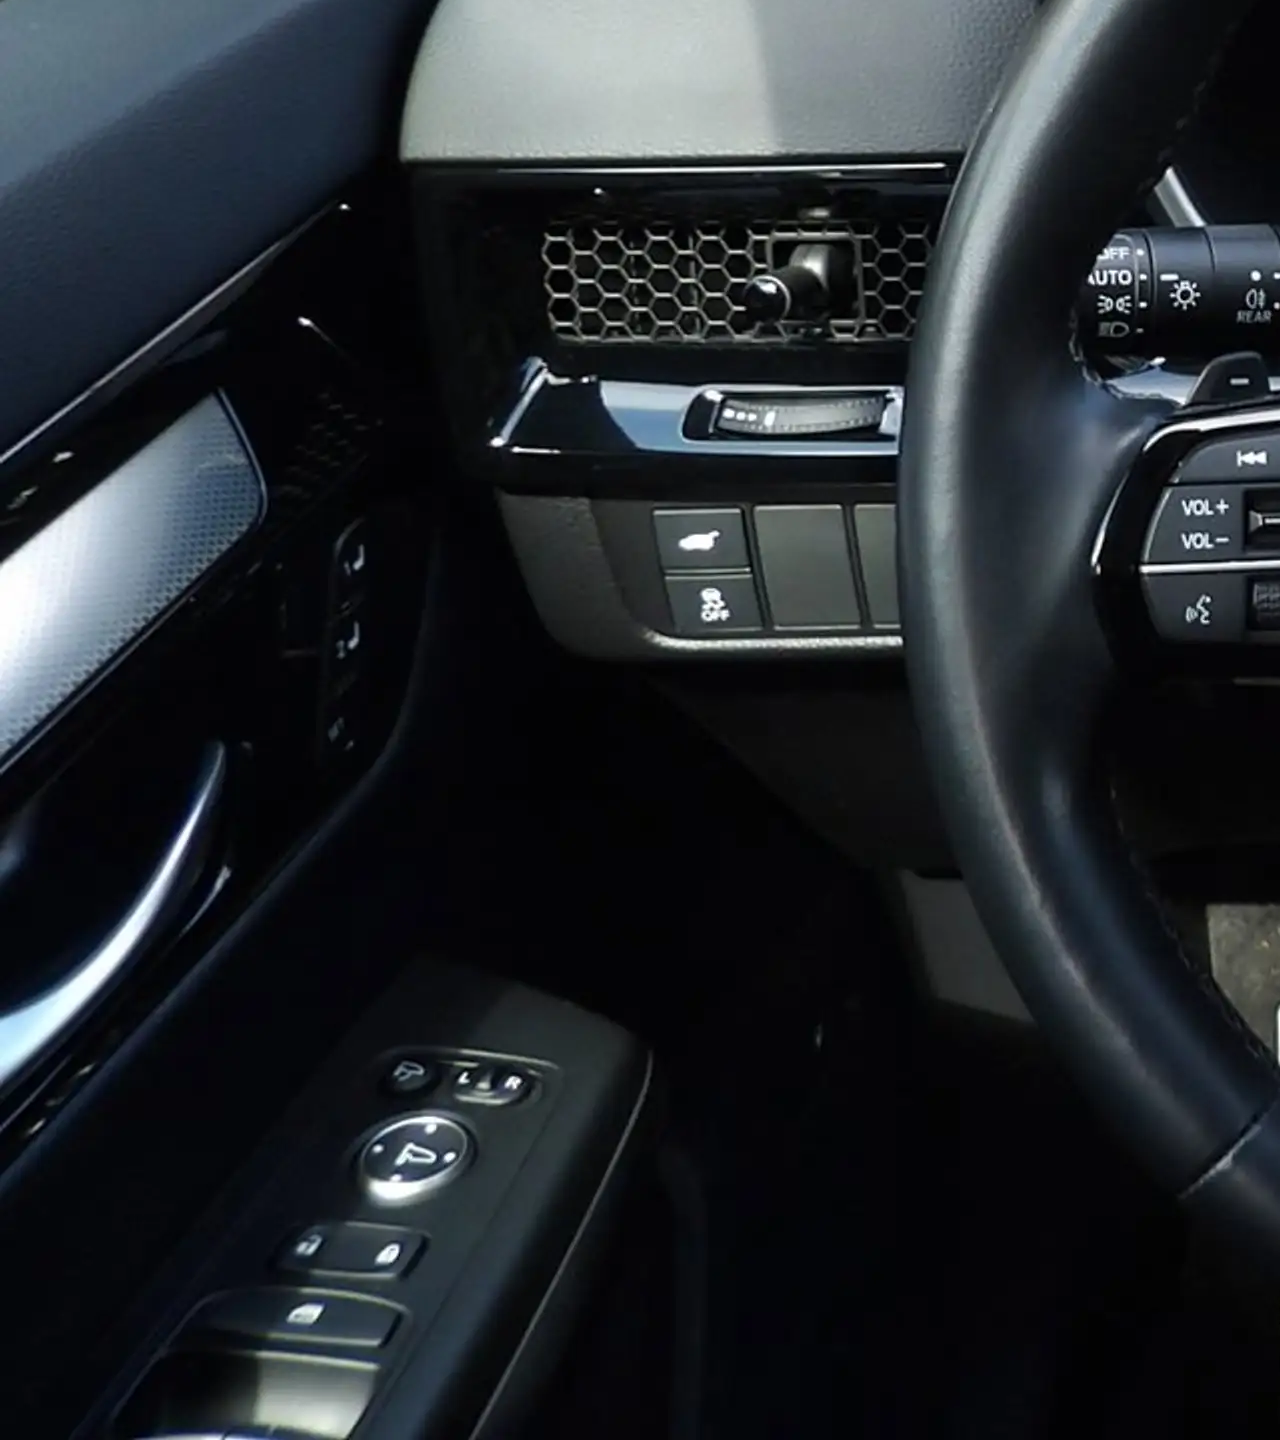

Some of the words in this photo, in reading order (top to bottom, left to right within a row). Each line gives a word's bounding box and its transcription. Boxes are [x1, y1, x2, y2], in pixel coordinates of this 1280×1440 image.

[1236, 307, 1272, 323] REAR
[700, 609, 731, 622] OFF
[457, 1071, 470, 1085] L
[503, 1075, 522, 1091] R
